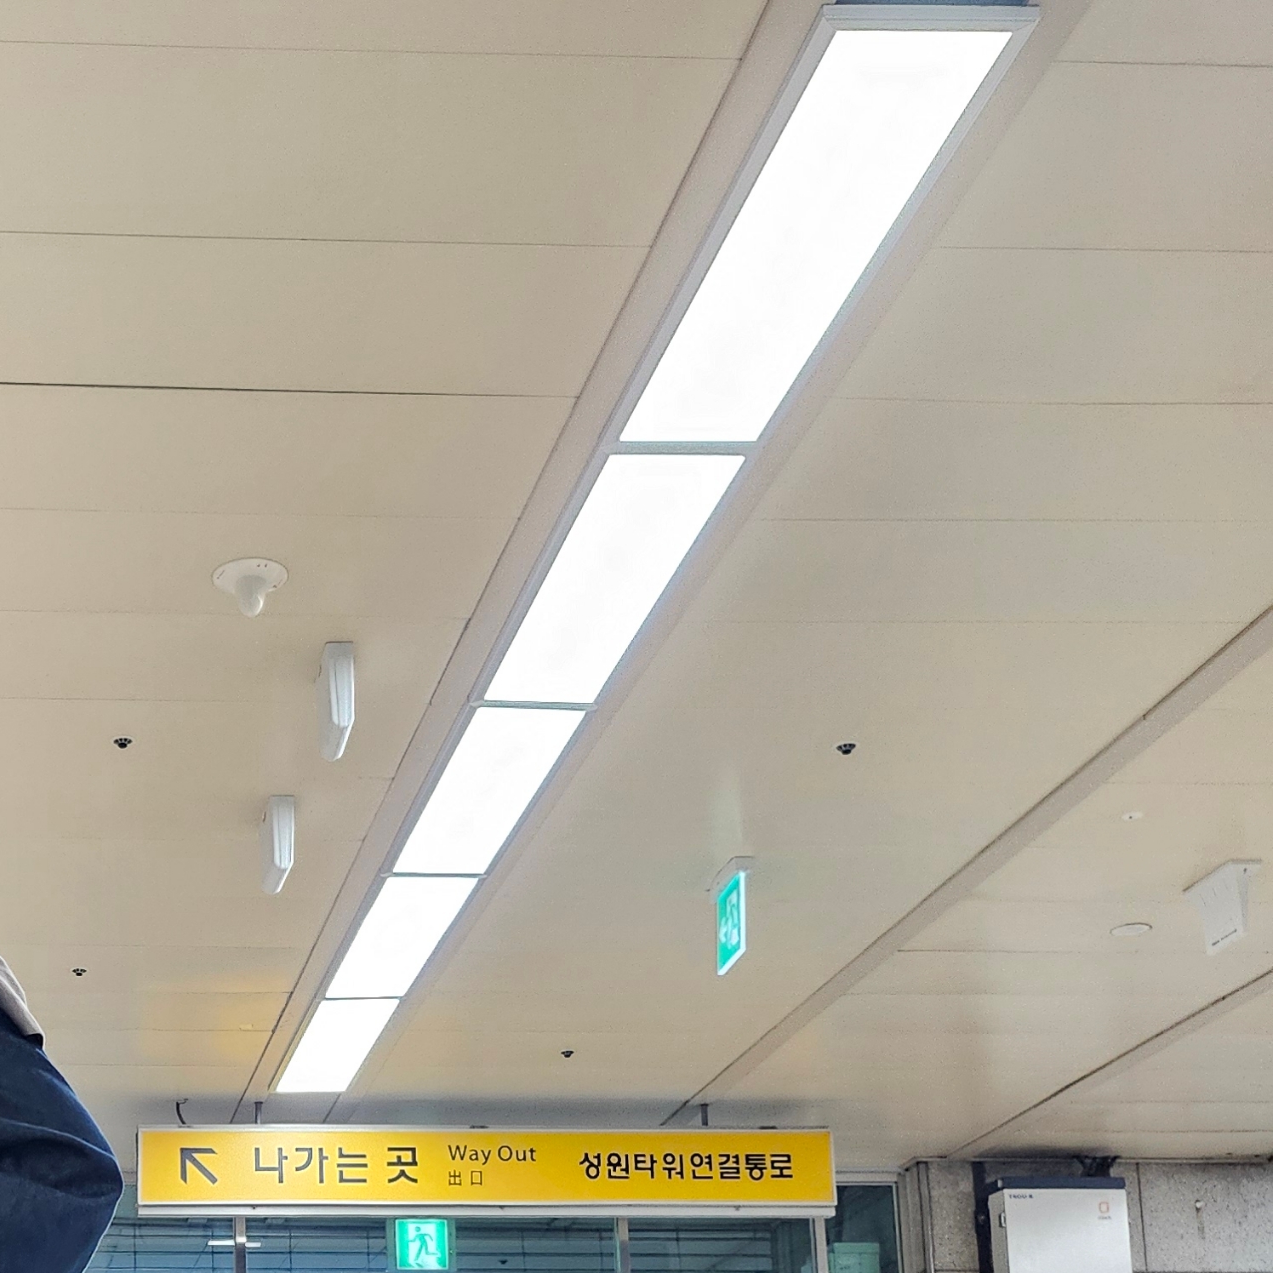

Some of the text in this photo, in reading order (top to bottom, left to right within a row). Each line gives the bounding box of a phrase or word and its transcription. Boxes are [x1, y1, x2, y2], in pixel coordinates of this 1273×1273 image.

[254, 1146, 419, 1184] 나가는 곳
[448, 1145, 537, 1166] Way Out
[579, 1152, 794, 1182] 성원타워연결통로
[448, 1169, 483, 1187] 出口
